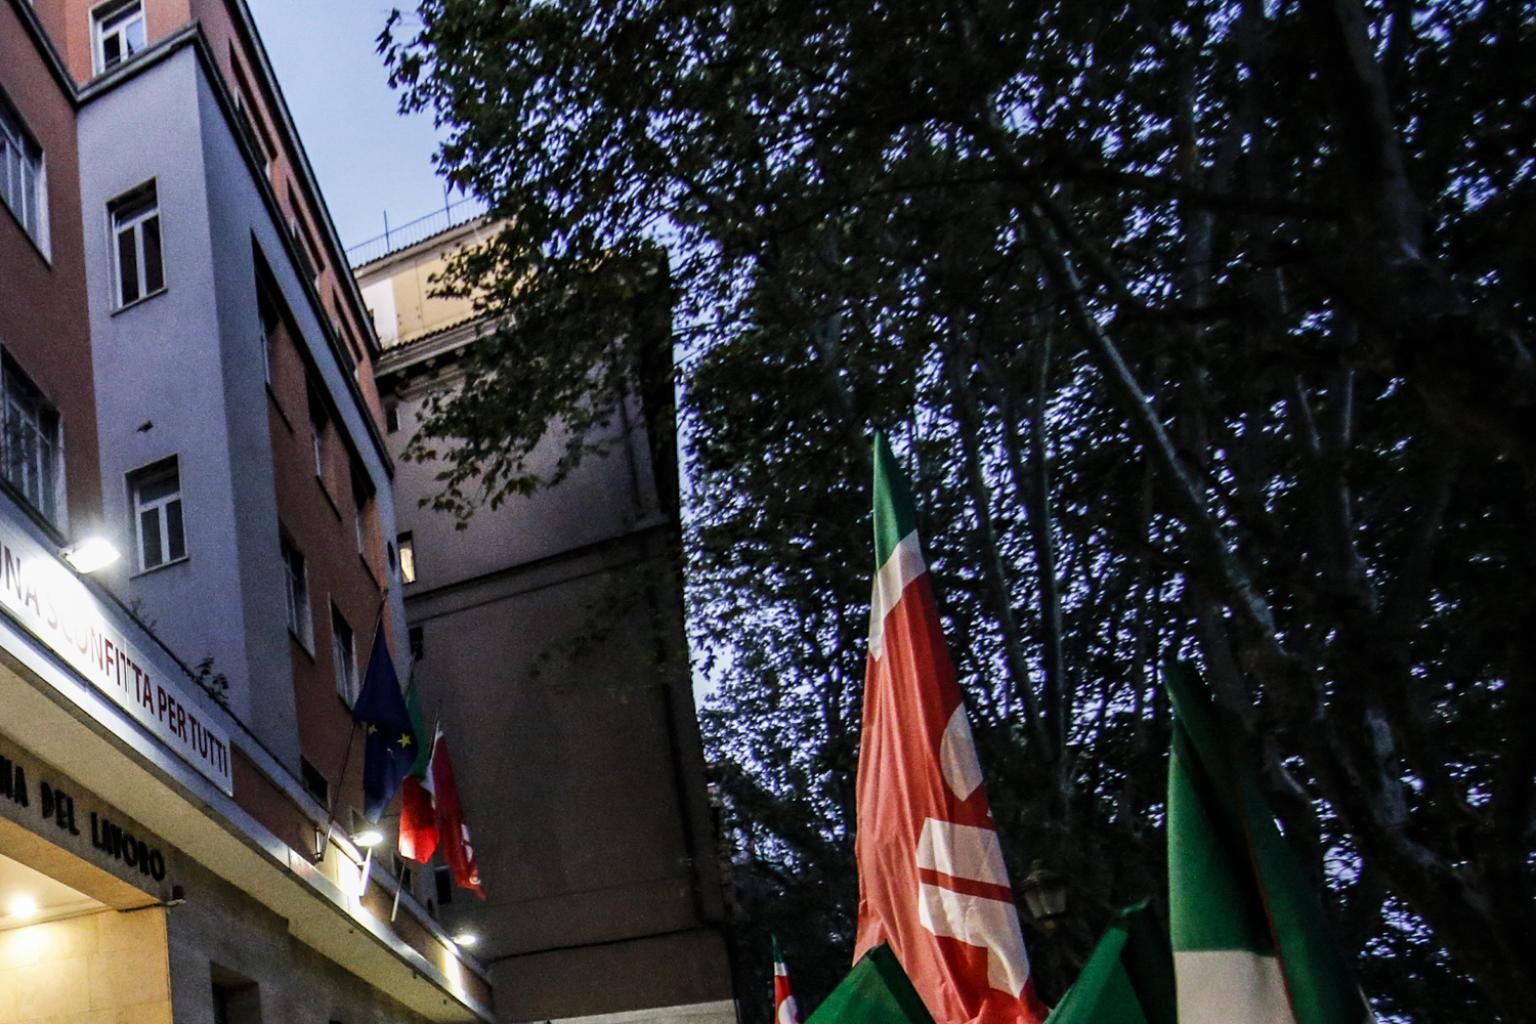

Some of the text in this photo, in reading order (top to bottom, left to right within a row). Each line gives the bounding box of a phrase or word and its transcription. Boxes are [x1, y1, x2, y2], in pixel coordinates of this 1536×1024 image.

[46, 588, 155, 715] SONFITTA
[157, 684, 188, 742] PER
[187, 715, 229, 778] TUTTI
[40, 781, 81, 836] DEL
[90, 811, 165, 882] LAVORO
